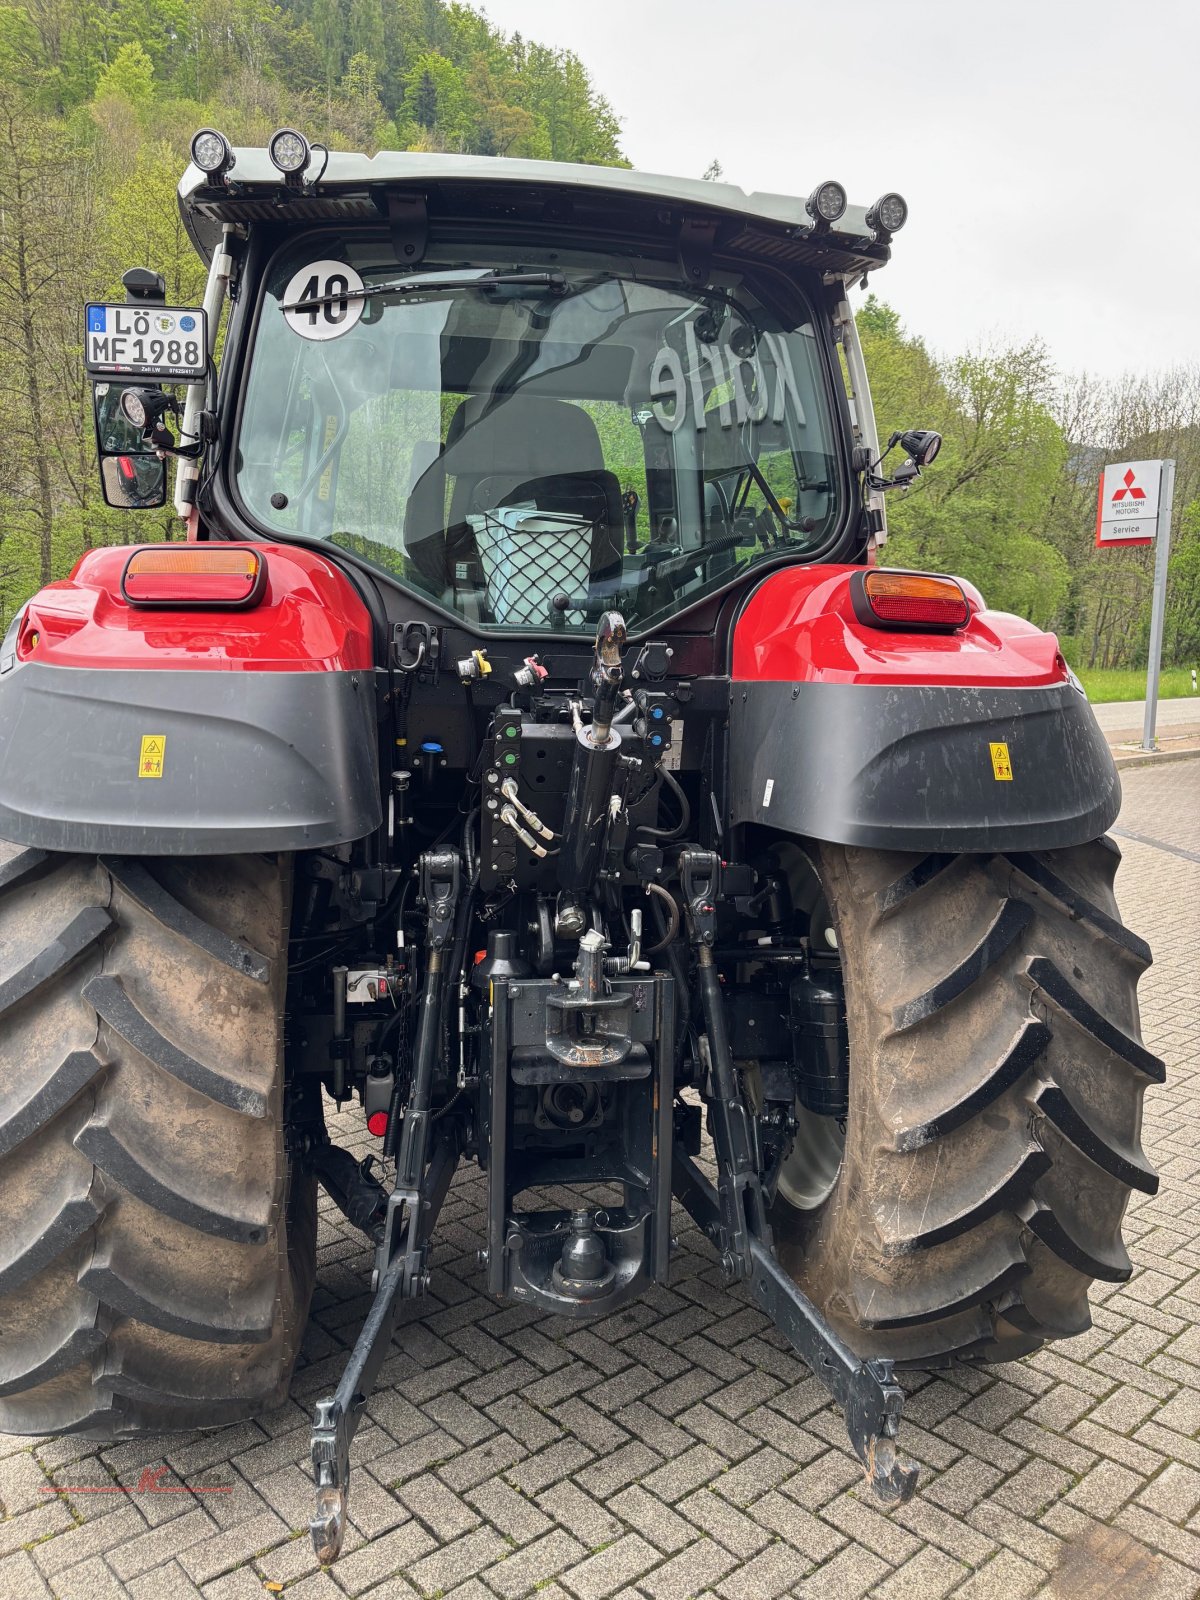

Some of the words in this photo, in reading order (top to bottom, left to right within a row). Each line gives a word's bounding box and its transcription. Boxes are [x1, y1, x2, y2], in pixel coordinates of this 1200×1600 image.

[294, 274, 349, 325] 40
[94, 323, 101, 331] D
[1112, 501, 1145, 509] MITSUBISHI
[1115, 507, 1140, 516] MOTORS
[1113, 525, 1140, 535] Service
